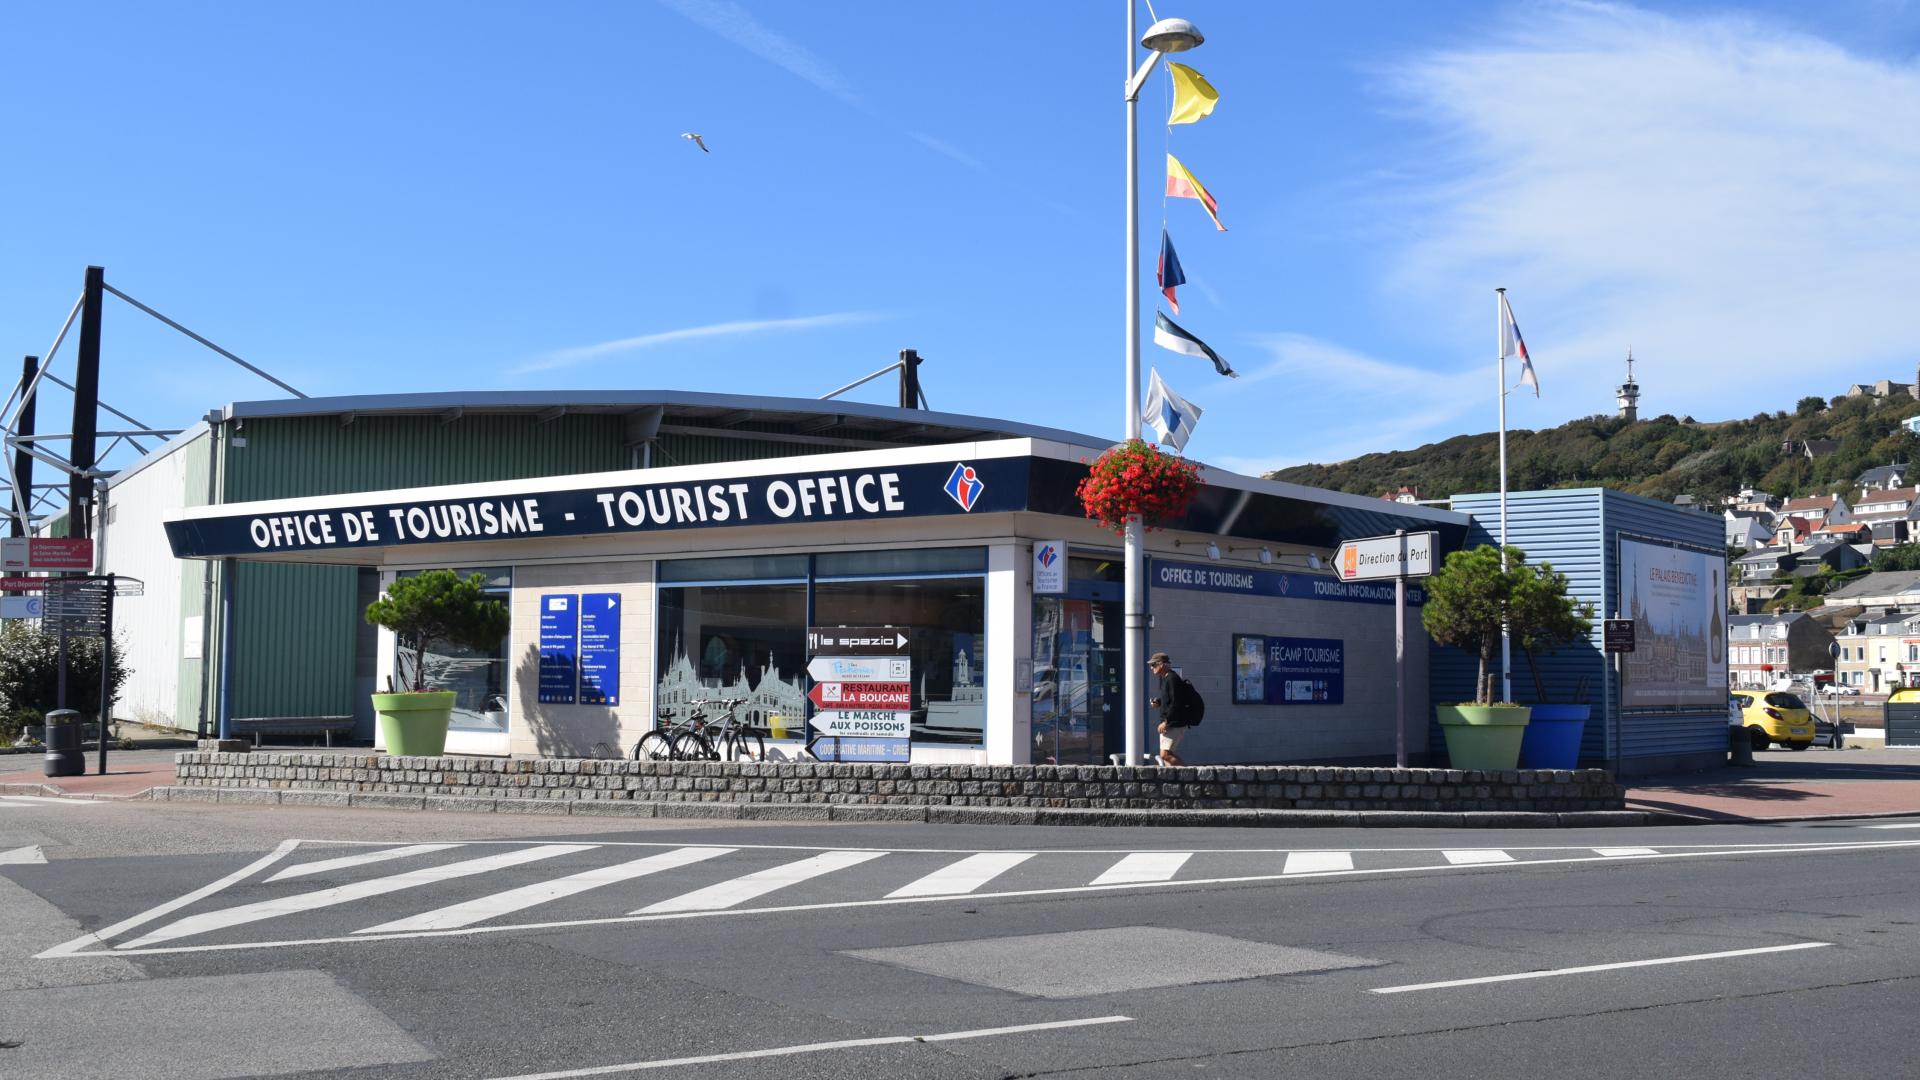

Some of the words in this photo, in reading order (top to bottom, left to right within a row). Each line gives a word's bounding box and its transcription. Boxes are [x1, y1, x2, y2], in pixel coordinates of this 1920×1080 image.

[250, 514, 336, 548] OFFICE
[341, 511, 379, 542] DE
[389, 499, 544, 539] TOURISME
[565, 512, 575, 521] -
[597, 483, 749, 527] TOURIST
[766, 473, 904, 518] OFFICE
[1359, 552, 1395, 565] Direction
[1397, 549, 1406, 562] du
[1411, 547, 1428, 561] Port
[1161, 567, 1193, 583] OFFICE
[1194, 570, 1207, 585] DE
[1208, 571, 1254, 590] TOURISME
[1314, 581, 1348, 596] TOURISM
[1348, 584, 1396, 600] INFORMATION
[1406, 590, 1422, 601] NTER
[820, 634, 834, 645] le
[839, 635, 895, 648] spazio
[1270, 642, 1302, 662] FÉCAMP
[1303, 647, 1341, 663] TOURISME
[843, 683, 909, 693] RESTAURANT
[843, 693, 855, 702] LA
[860, 693, 909, 703] BOUCANE
[838, 711, 850, 720] LE
[853, 710, 896, 721] MARCHÉ
[830, 721, 851, 730] AUX
[855, 722, 905, 731] POISSONS
[857, 743, 886, 756] MARITIME
